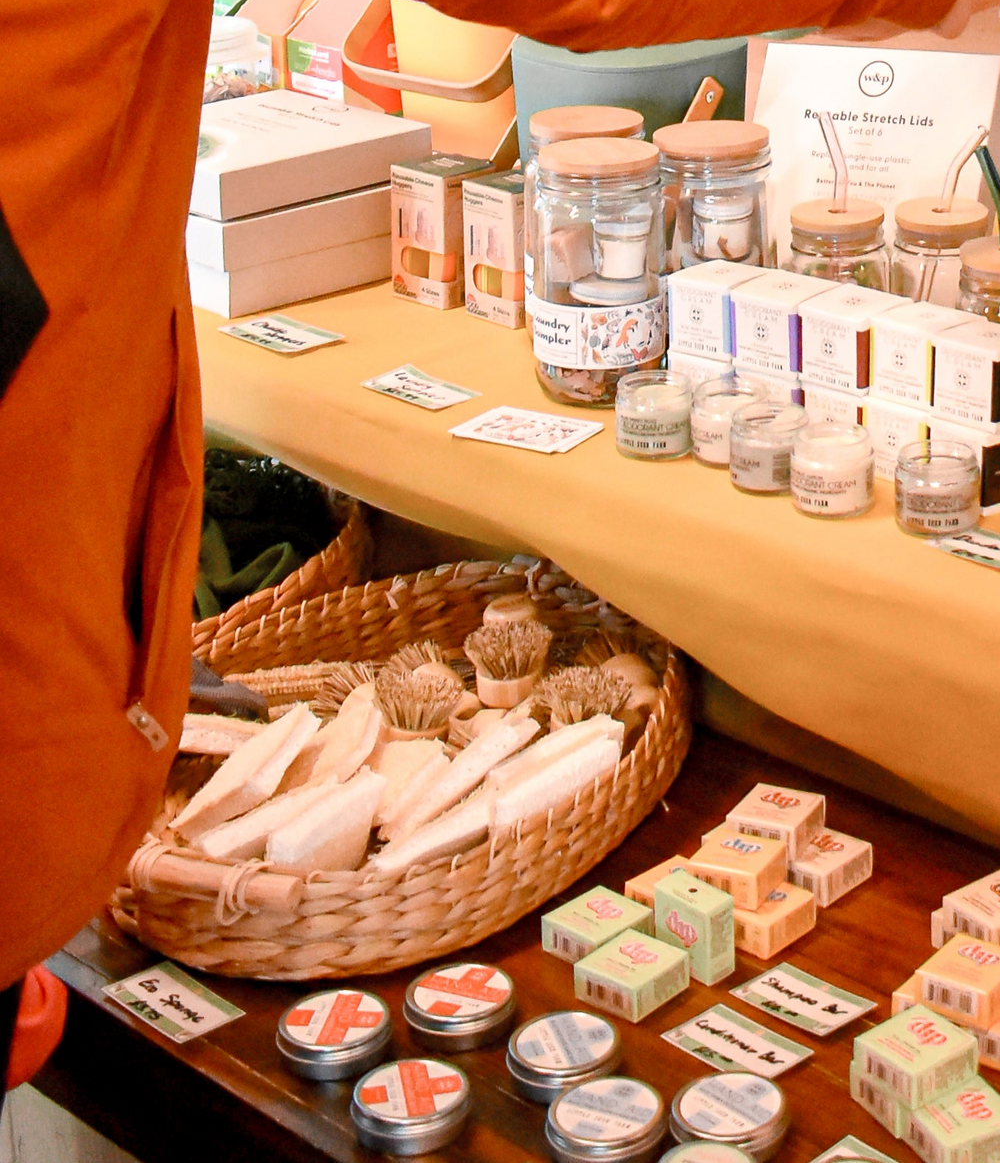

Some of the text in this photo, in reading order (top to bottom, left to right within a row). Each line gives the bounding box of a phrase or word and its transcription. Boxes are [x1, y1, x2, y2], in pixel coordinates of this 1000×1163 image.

[864, 72, 889, 85] w&p
[862, 112, 906, 126] Stretch
[909, 115, 934, 127] Lids
[848, 126, 883, 136] Set of 6
